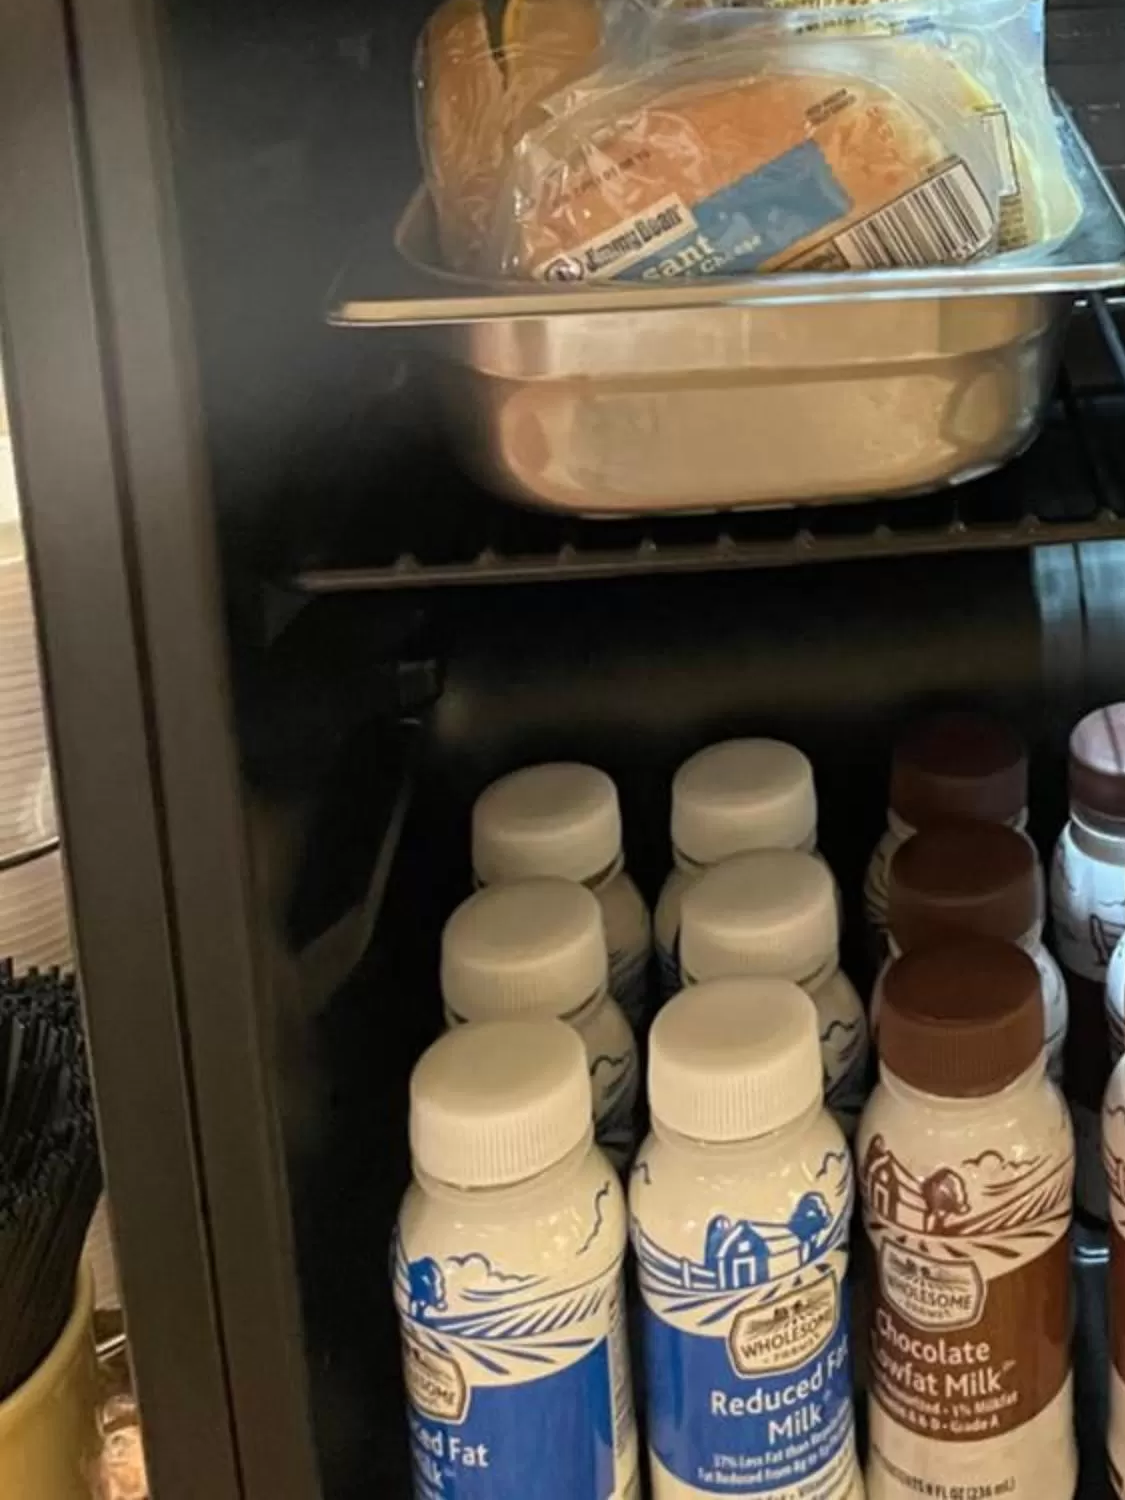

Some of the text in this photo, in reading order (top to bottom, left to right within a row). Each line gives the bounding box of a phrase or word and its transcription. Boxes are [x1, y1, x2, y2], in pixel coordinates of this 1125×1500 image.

[585, 204, 682, 271] Jimmy Dean
[740, 1314, 825, 1359] WHOLESO
[876, 1307, 991, 1366] Chocolate
[710, 1362, 824, 1417] Reduced
[945, 1367, 1001, 1398] Milk
[769, 1403, 823, 1446] Milk
[990, 1413, 1000, 1428] A
[448, 1436, 489, 1468] Fat
